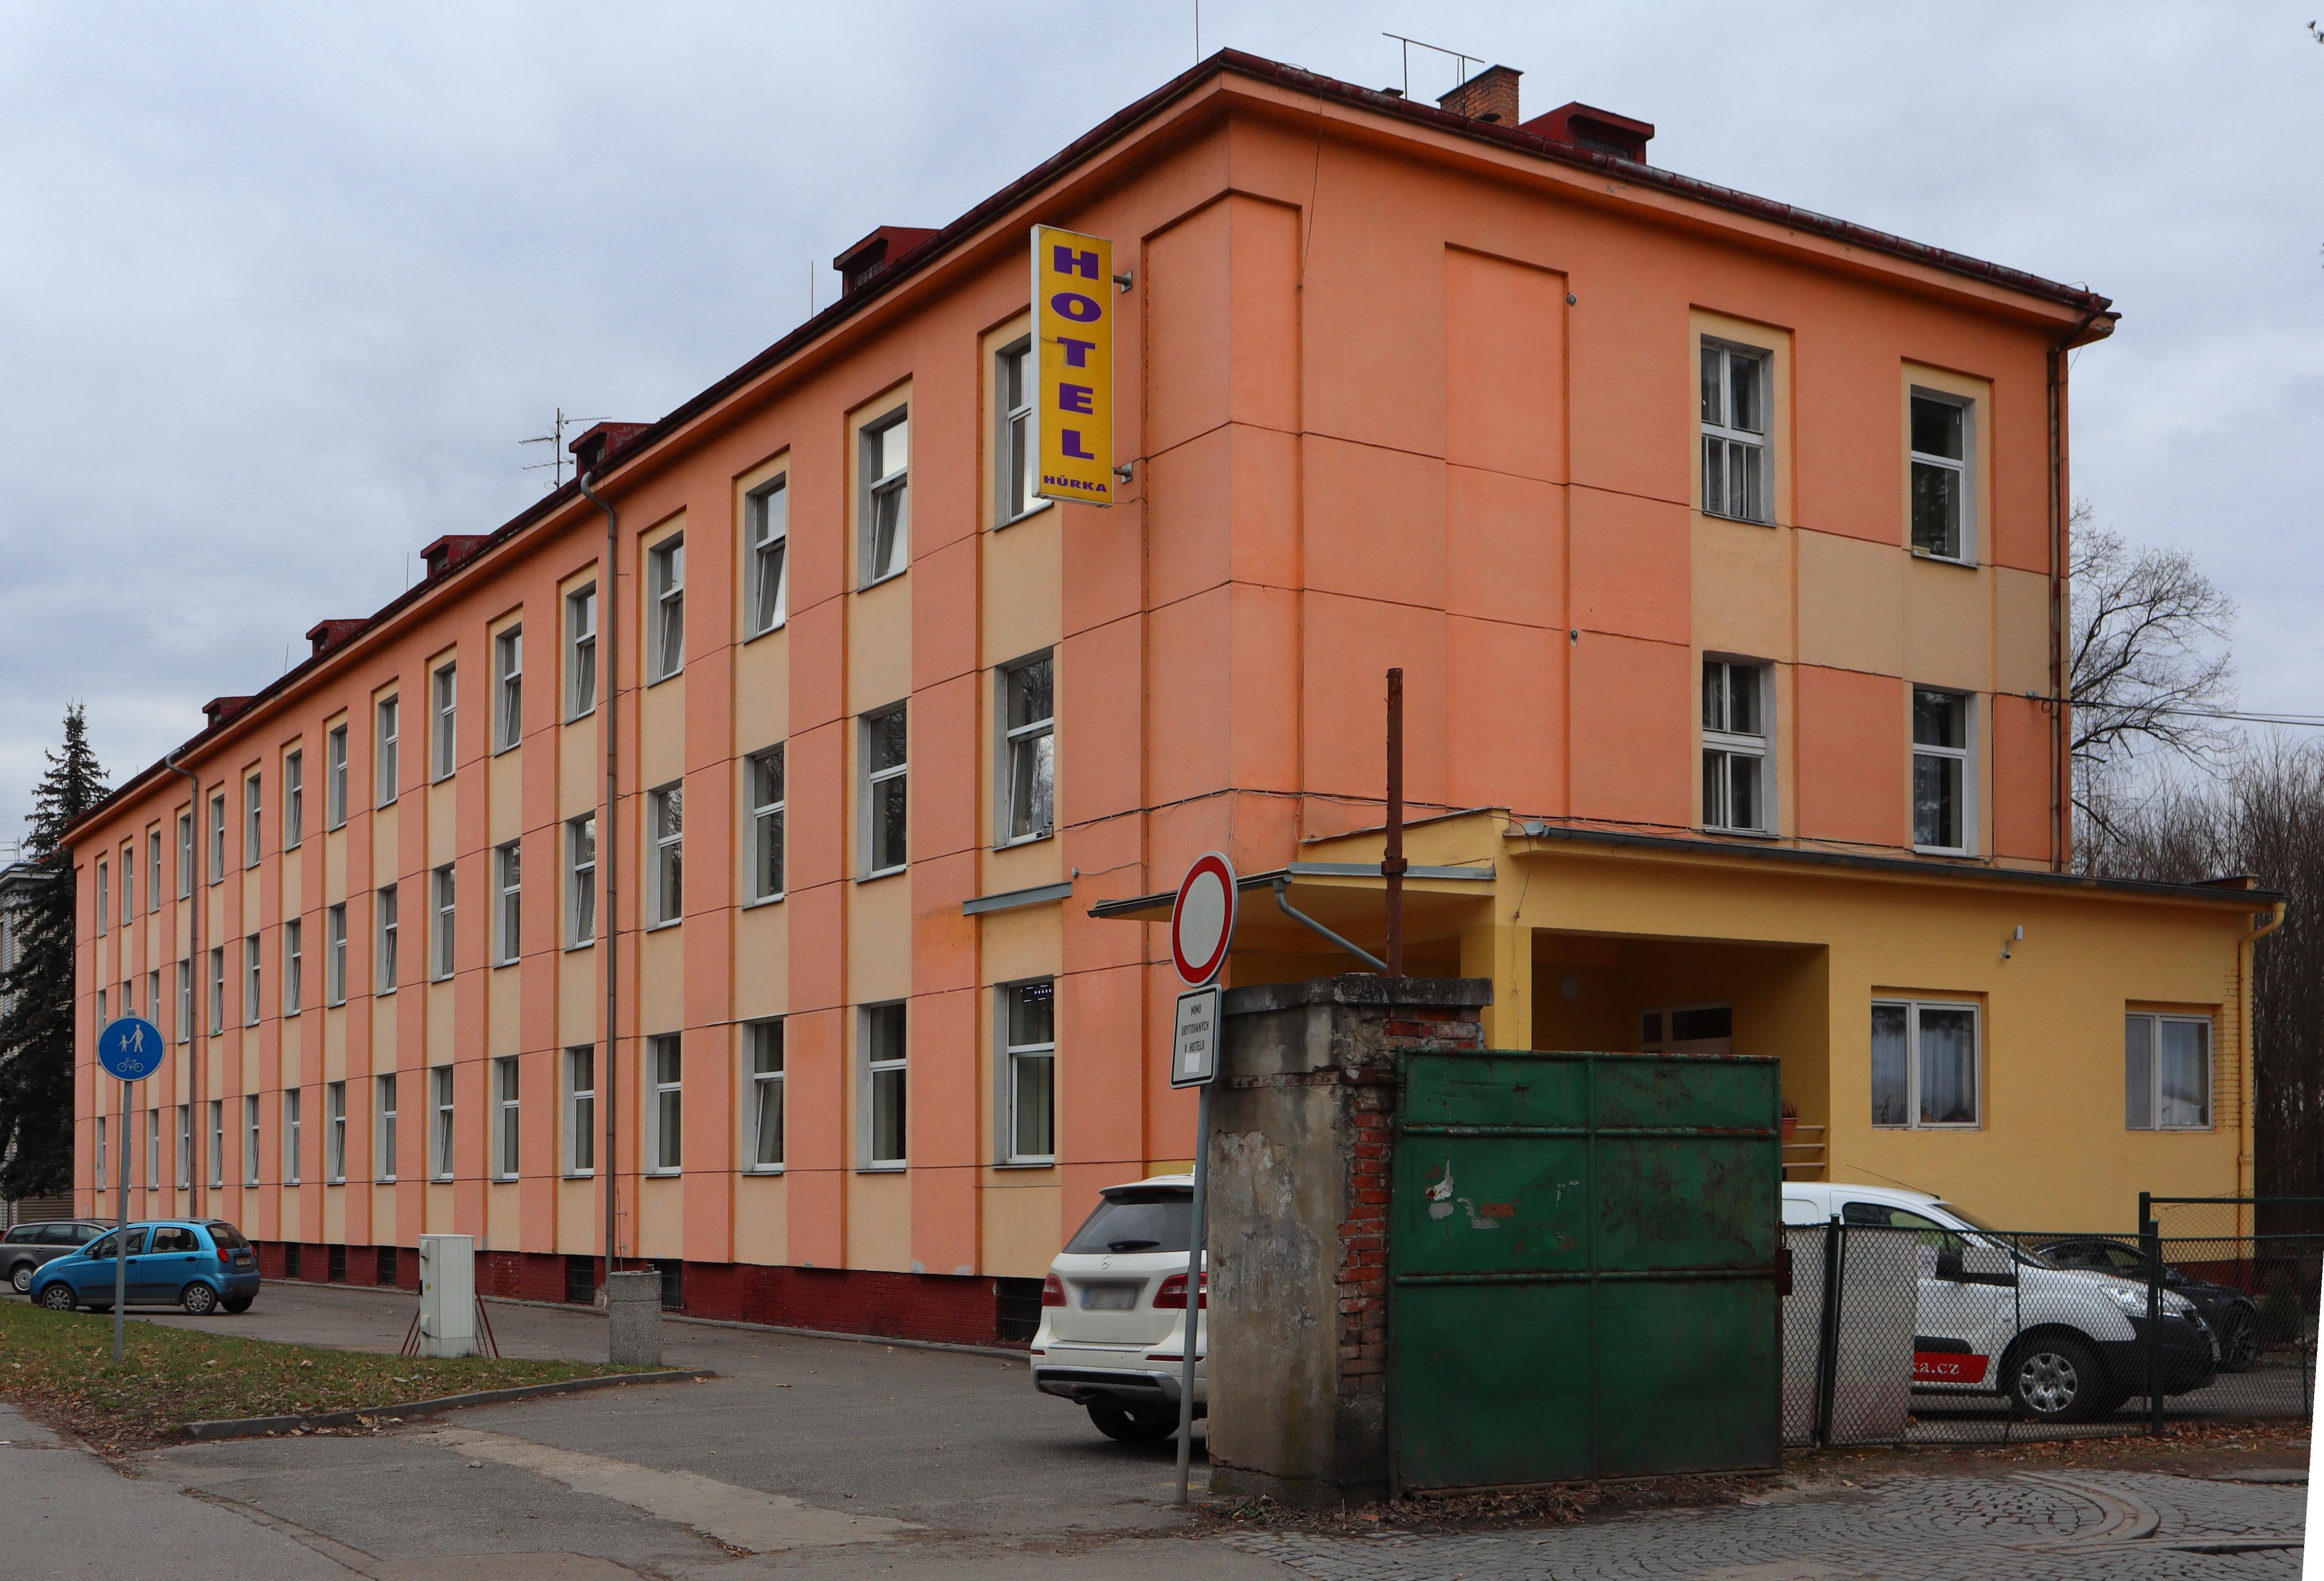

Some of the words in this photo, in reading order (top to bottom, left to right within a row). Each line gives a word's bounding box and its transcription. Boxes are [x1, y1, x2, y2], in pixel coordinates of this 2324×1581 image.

[1050, 245, 1102, 460] HOTEL
[1043, 475, 1107, 493] HŮRKA
[1191, 1003, 1202, 1015] MIMO
[1181, 1019, 1209, 1036] UBYTOVANÝCH
[1184, 1044, 1188, 1054] V
[1189, 1040, 1205, 1053] HOTELU
